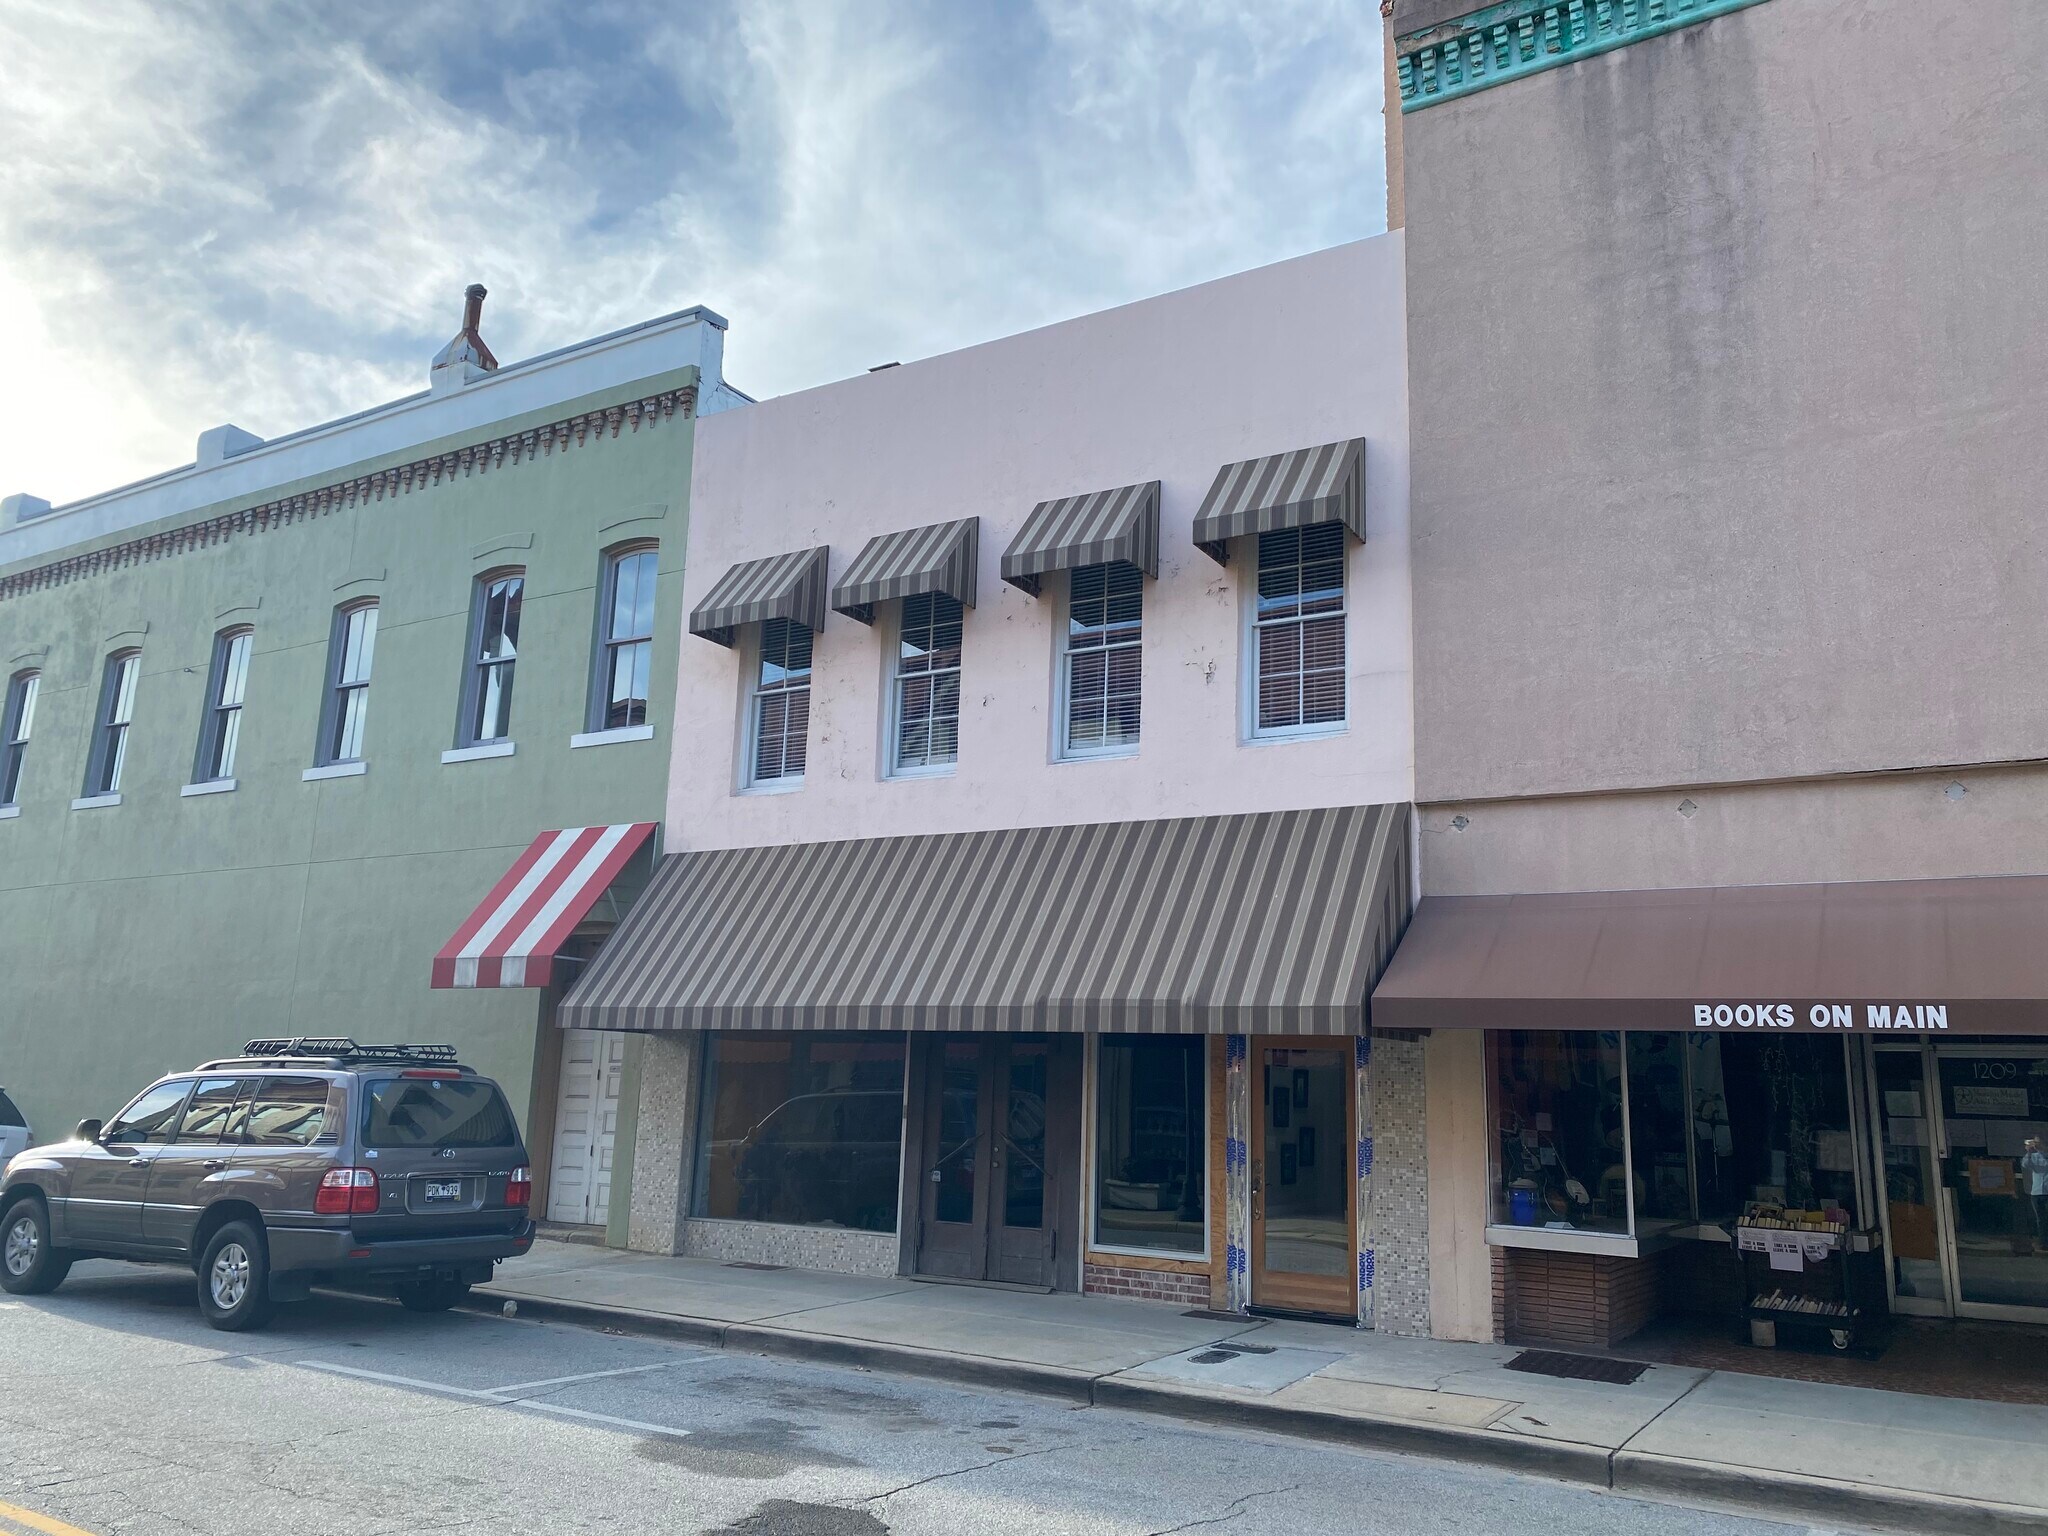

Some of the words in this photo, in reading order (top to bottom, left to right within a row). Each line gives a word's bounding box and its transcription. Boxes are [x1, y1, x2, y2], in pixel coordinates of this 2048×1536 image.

[1694, 1004, 1794, 1027] BOOKS
[1809, 1005, 1853, 1027] ON
[1867, 1005, 1948, 1029] MAIN
[1972, 1062, 2017, 1080] 1209
[446, 1185, 458, 1195] 939
